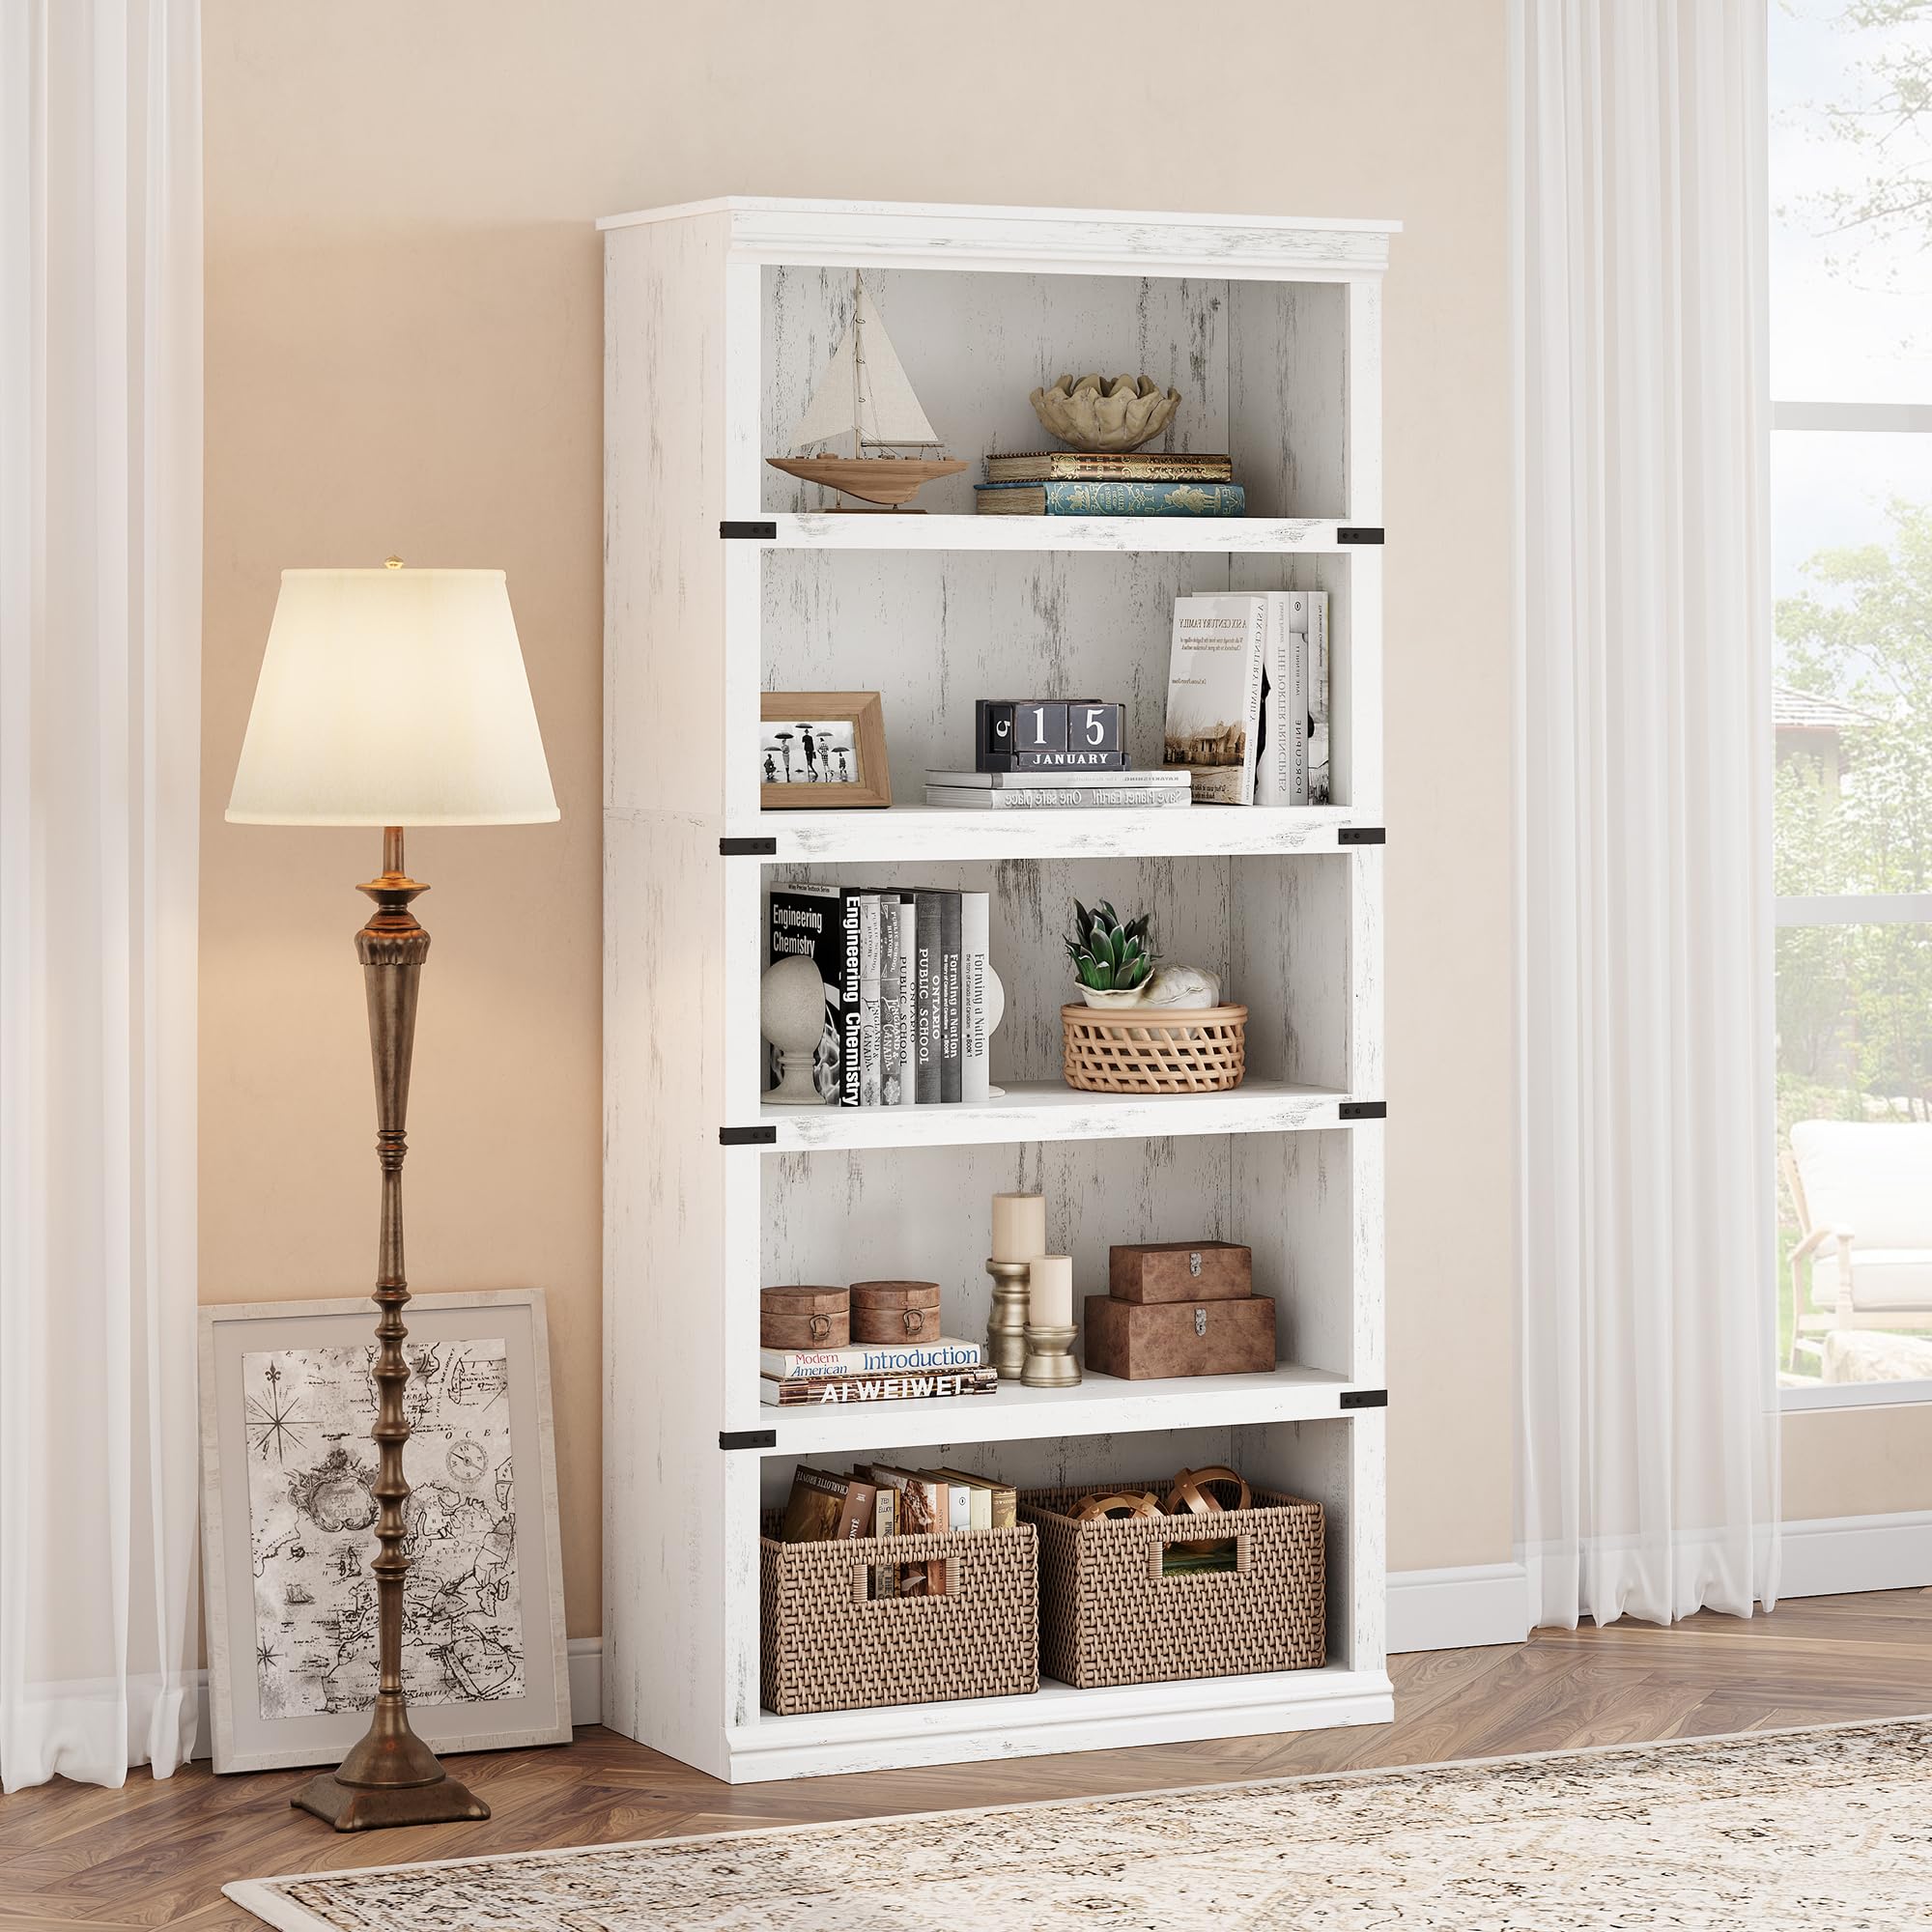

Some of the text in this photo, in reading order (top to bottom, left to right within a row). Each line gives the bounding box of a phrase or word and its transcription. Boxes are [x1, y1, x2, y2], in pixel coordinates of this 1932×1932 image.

[1033, 707, 1047, 744] 1
[1086, 709, 1105, 746] 5
[1032, 753, 1109, 765] JANUARY
[773, 904, 822, 933] Engineering
[773, 931, 815, 958] Chemistry
[890, 941, 898, 972] SCHOOL
[949, 954, 958, 1005] Forming
[972, 953, 985, 1004] Forming
[842, 896, 860, 1105] Engineering Chemistry
[920, 949, 928, 1065] PUBLIC SCHOOL
[862, 997, 880, 1051] ENGLAND
[881, 997, 899, 1050] ENGLAND
[975, 1017, 985, 1057] Nation
[791, 1365, 847, 1377] American
[796, 1352, 838, 1365] Modern
[864, 1347, 978, 1370] Introduction
[820, 1376, 961, 1403] AI WEIWEI
[817, 1477, 848, 1495] CHARLOTTE
